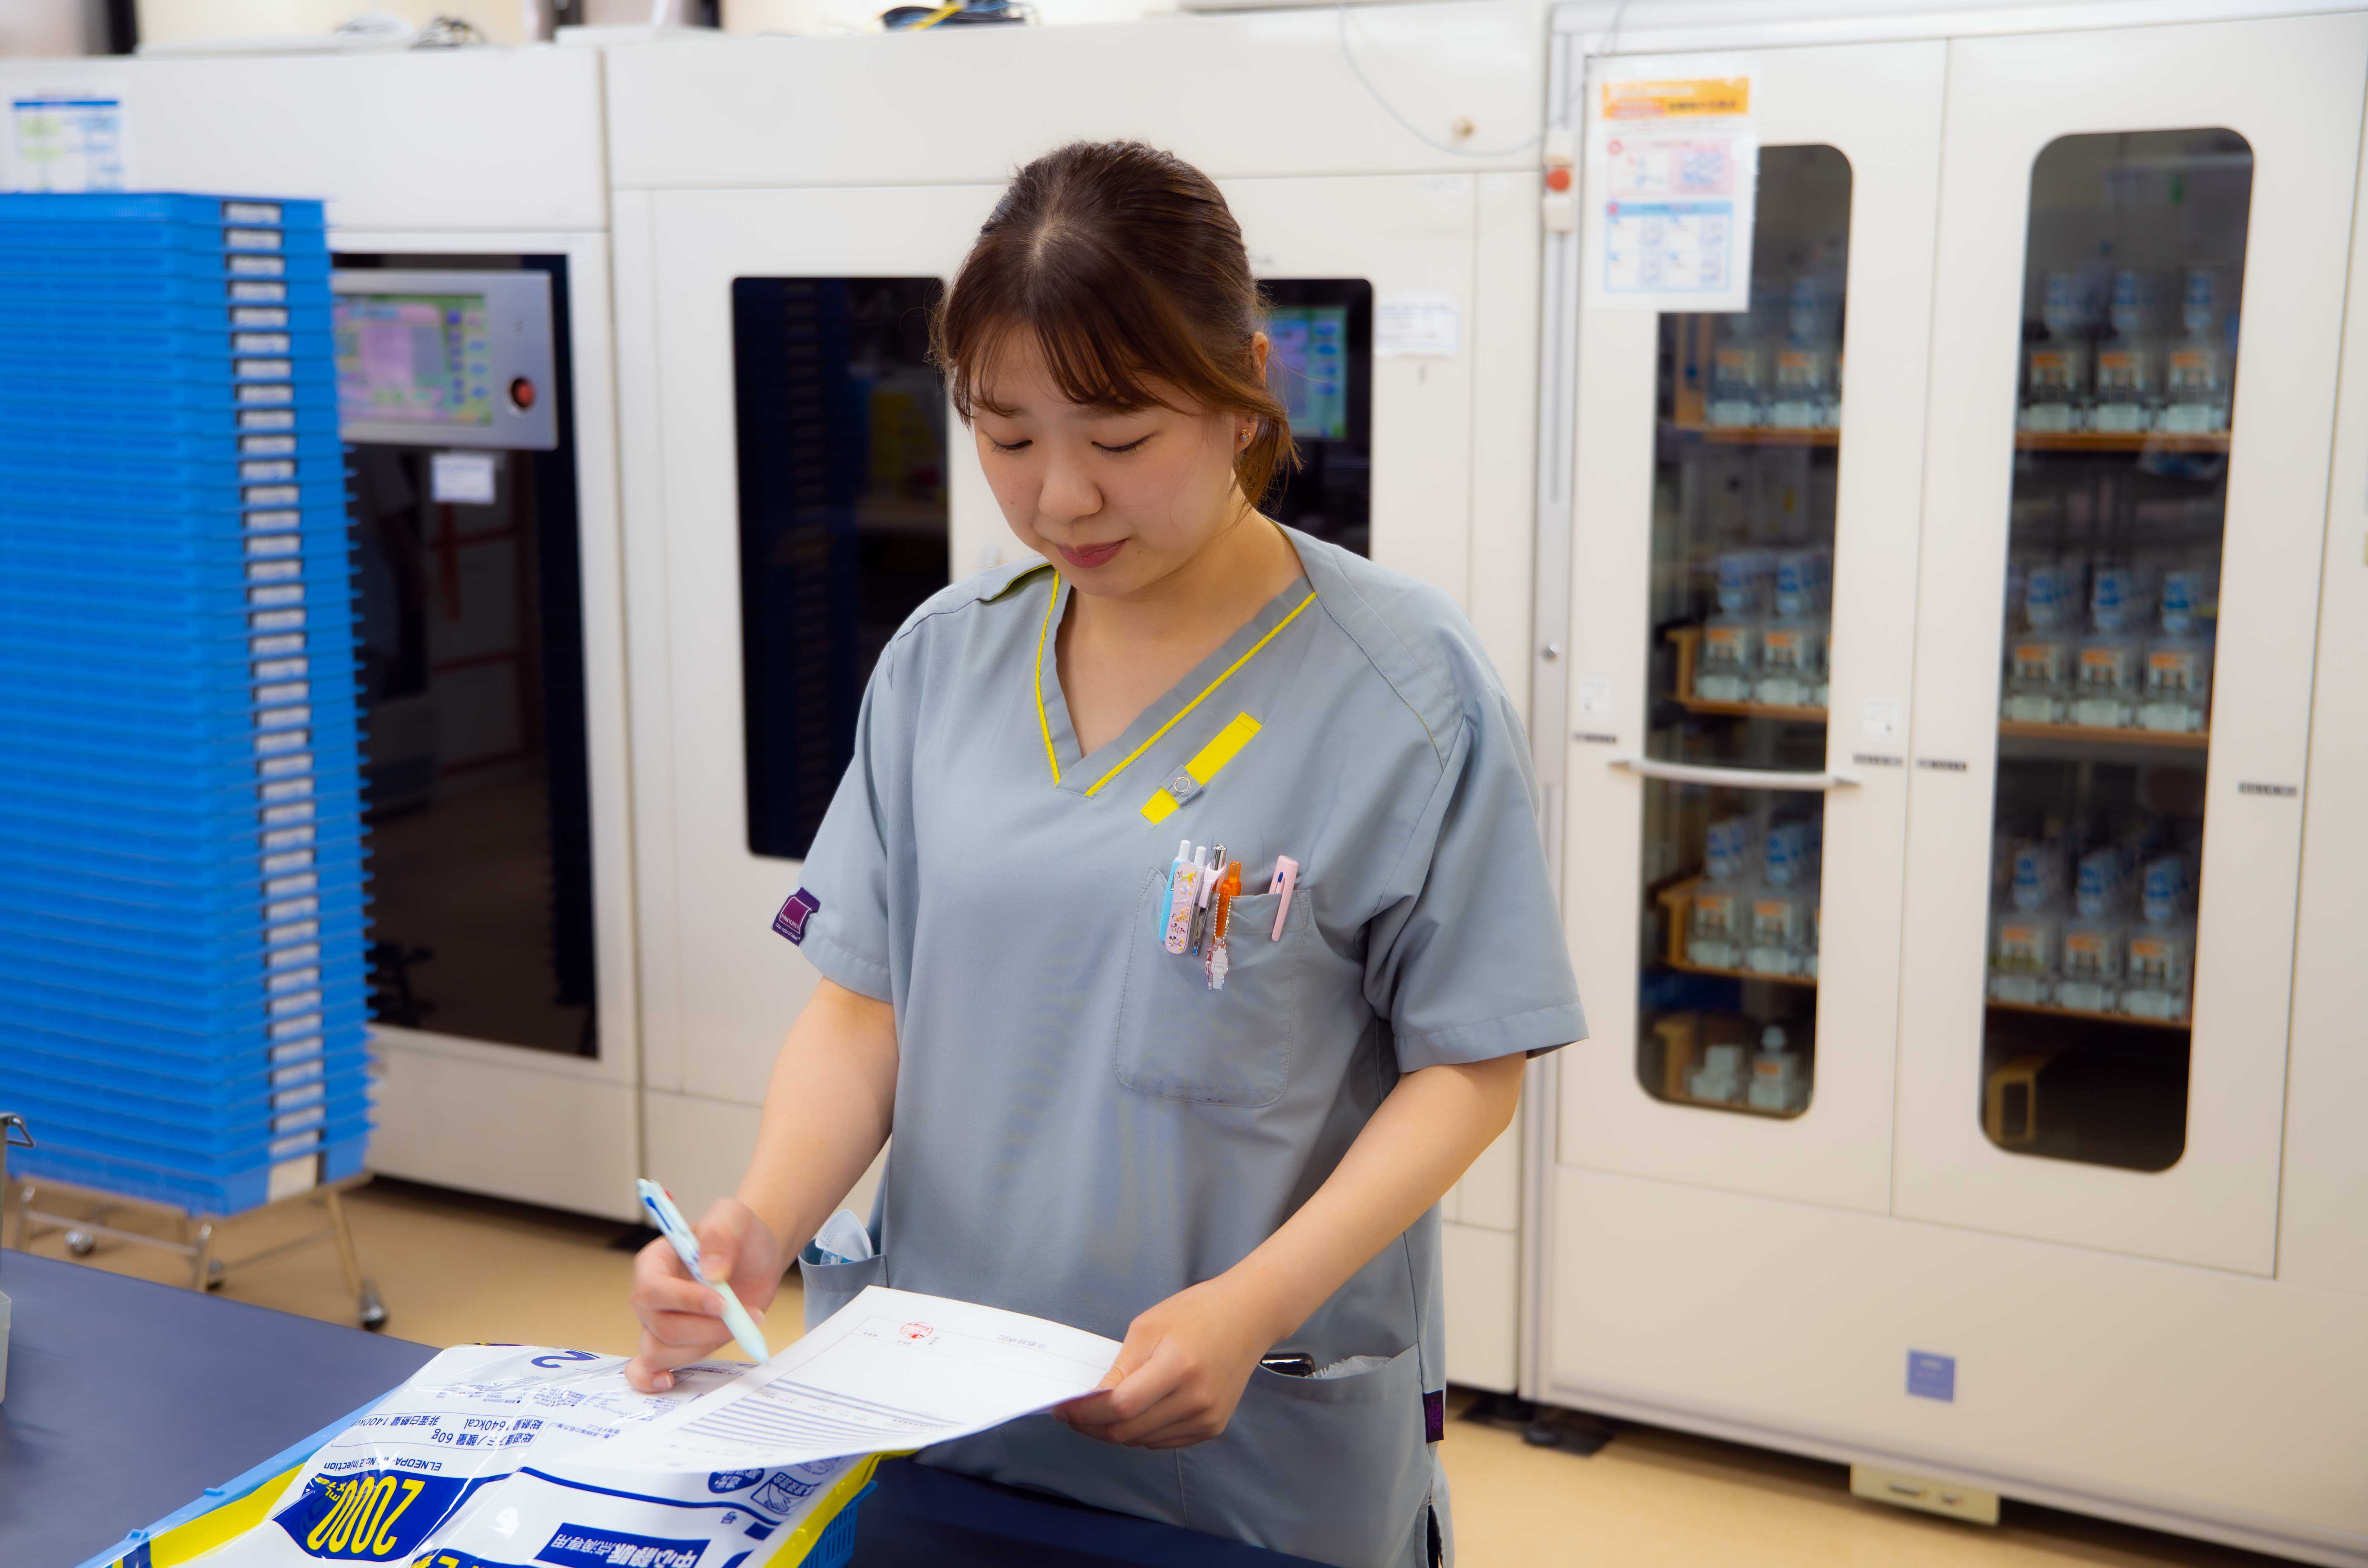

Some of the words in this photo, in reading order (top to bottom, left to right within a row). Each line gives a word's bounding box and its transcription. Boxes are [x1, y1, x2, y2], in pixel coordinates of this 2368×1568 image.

[350, 1417, 389, 1427] 1400kc
[390, 1415, 441, 1426] 非蛋白熱量
[431, 1429, 454, 1443] 60g
[324, 1460, 359, 1471] Injection
[359, 1457, 377, 1468] No.2
[378, 1456, 442, 1471] ELNEOPA-
[307, 1475, 425, 1556] 2000
